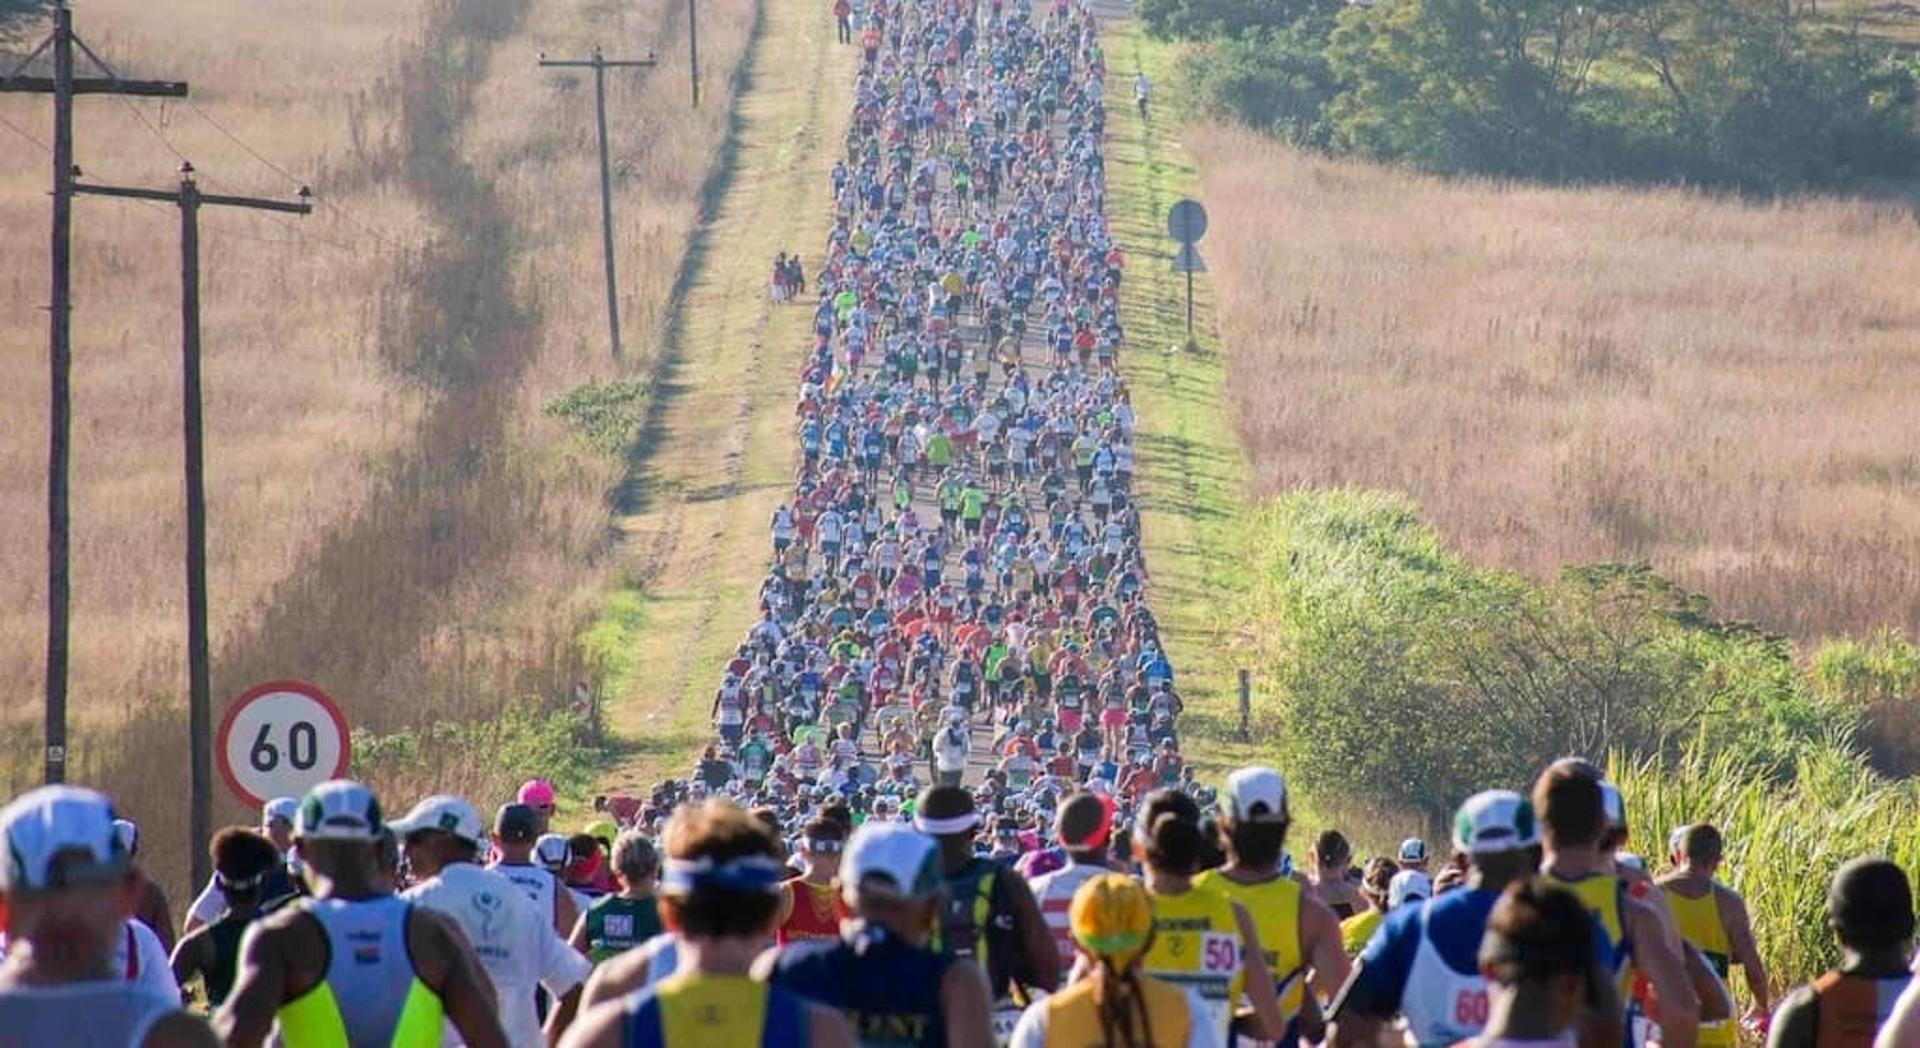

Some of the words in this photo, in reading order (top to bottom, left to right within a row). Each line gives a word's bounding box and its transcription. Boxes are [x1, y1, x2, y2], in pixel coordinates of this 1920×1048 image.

[251, 721, 317, 772] 60
[1206, 938, 1234, 970] 50
[1455, 989, 1489, 1027] 60
